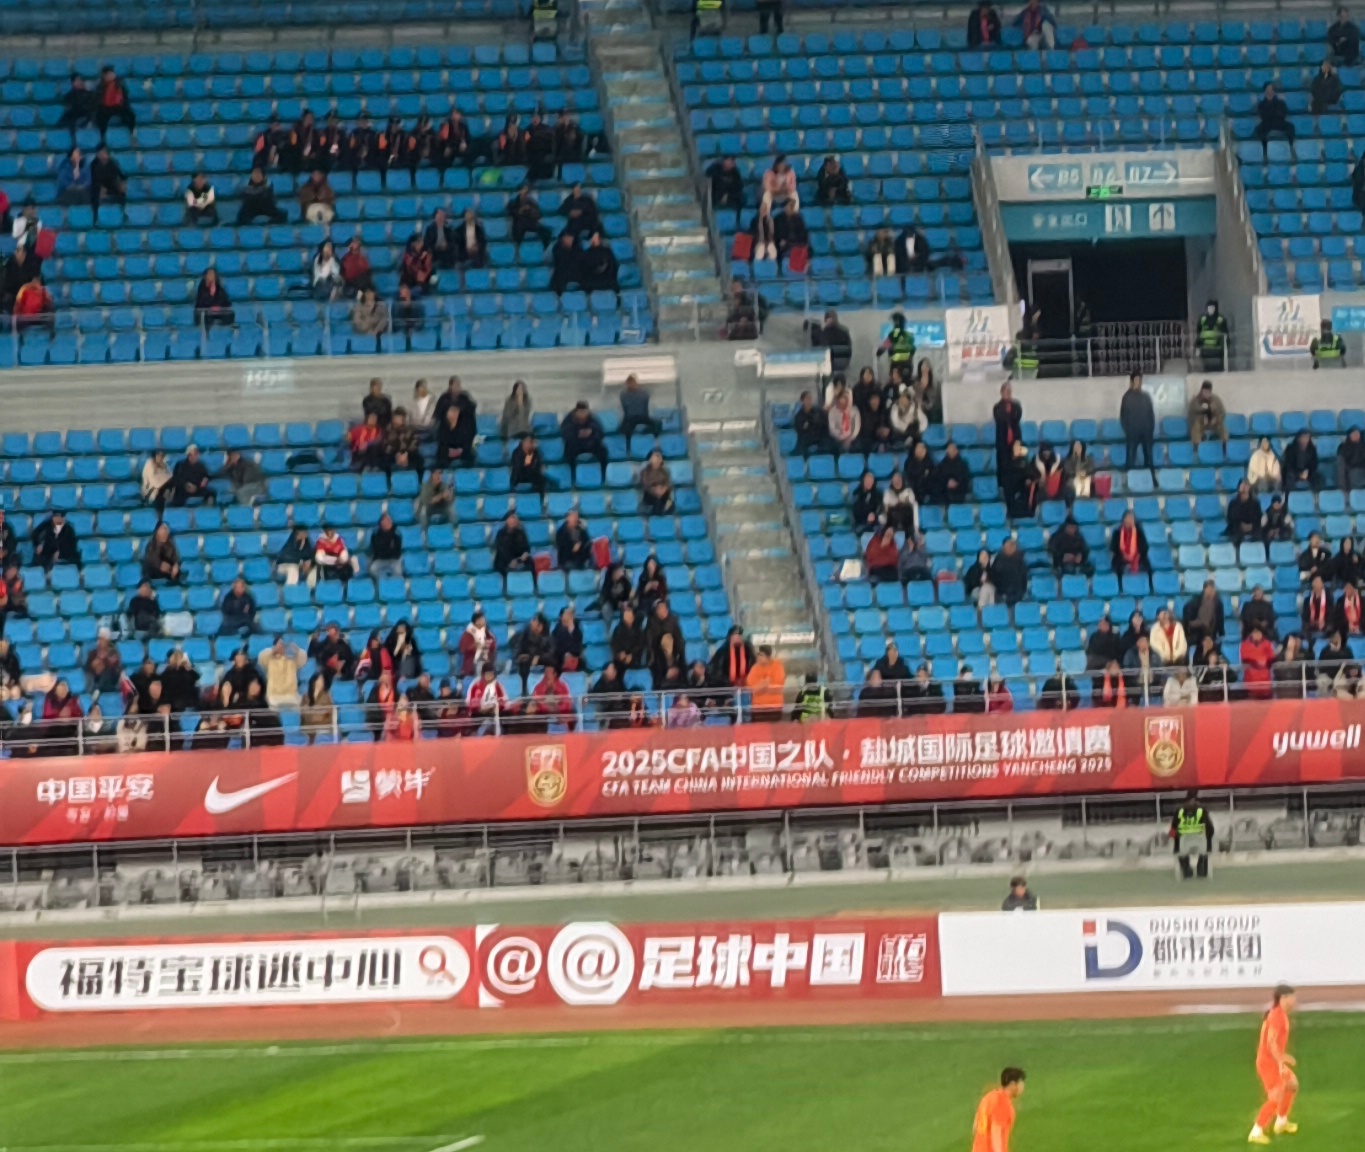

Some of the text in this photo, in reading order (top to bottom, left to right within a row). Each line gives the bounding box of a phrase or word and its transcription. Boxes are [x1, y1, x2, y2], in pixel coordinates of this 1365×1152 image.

[1273, 725, 1361, 758] yuwell
[1150, 915, 1260, 934] DUSHI GROUP
[638, 933, 866, 990] 足球中国
[1152, 933, 1261, 965] 都市集团
[60, 947, 402, 998] 福特宝球迷中心
